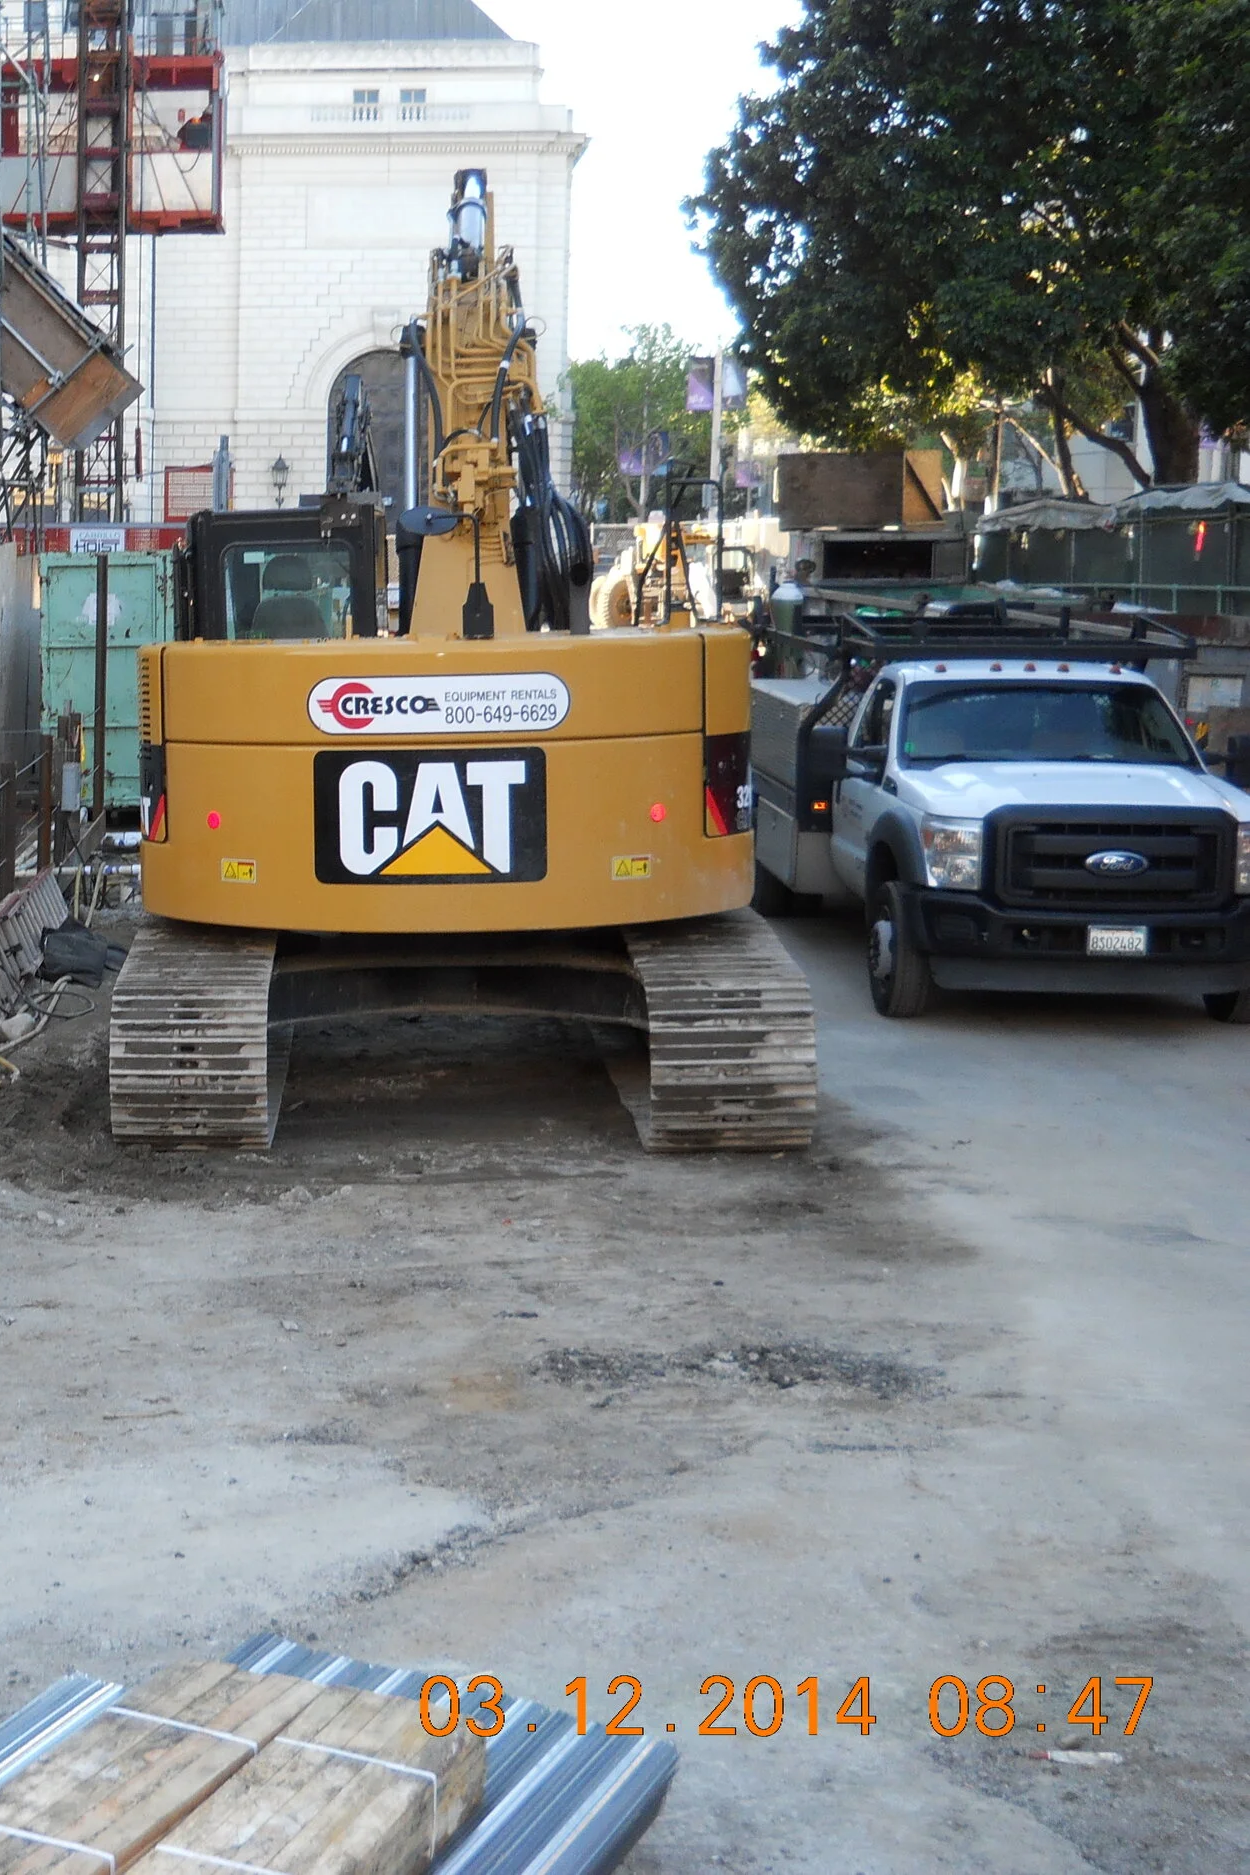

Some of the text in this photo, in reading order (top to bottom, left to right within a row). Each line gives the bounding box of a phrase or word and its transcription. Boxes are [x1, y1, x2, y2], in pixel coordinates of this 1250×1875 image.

[74, 539, 119, 552] HOIST
[444, 688, 558, 702] EQUIPMENT RENTALS
[341, 695, 430, 716] CRESCO
[444, 704, 558, 725] 800-649-6629
[339, 761, 526, 875] CAT
[1100, 855, 1135, 871] Ford
